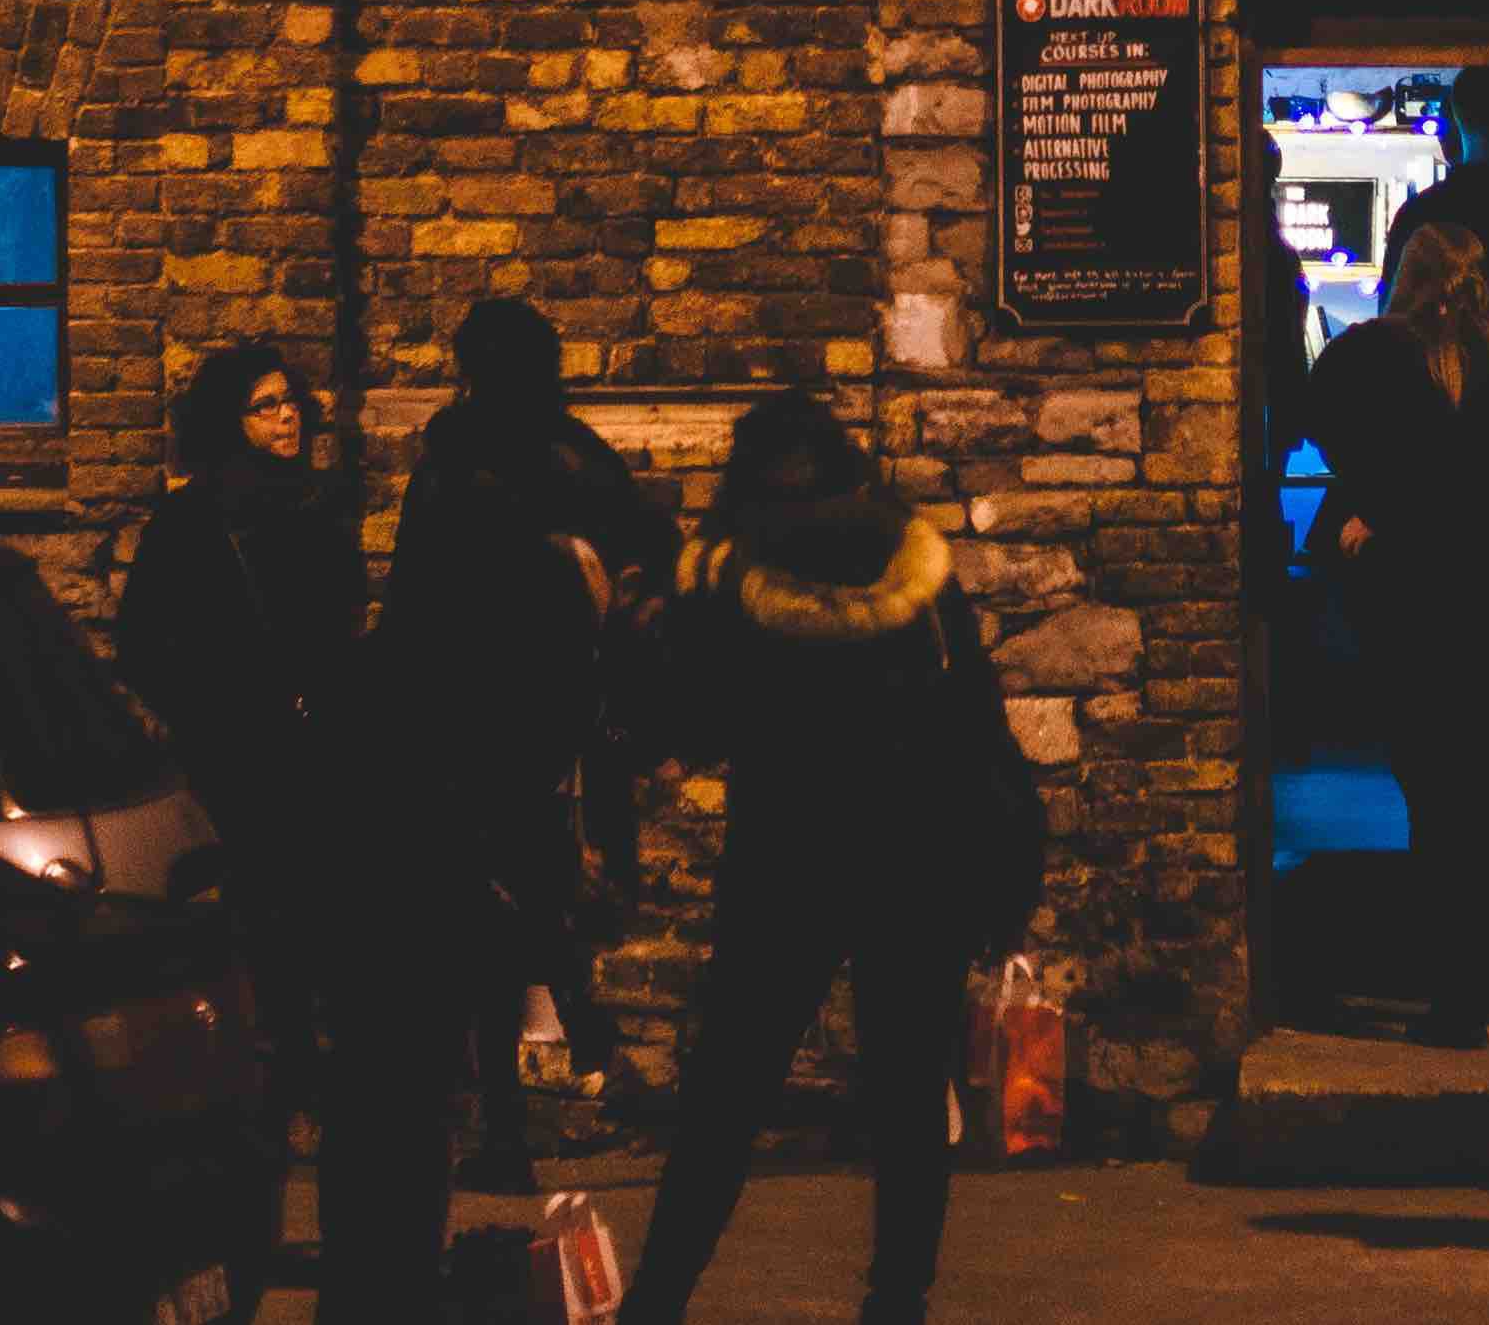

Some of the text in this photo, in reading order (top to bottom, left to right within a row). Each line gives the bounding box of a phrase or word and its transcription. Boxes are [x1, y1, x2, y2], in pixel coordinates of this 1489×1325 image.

[1041, 45, 1119, 62] COURSES
[1022, 69, 1168, 93] DIGITAL PHOTOGRAPHY
[1022, 91, 1157, 111] FILM PHOTOGRAPHY
[1023, 113, 1127, 135] MOTION FILM
[1023, 138, 1109, 159] ALTERNATIVE
[1024, 161, 1111, 182] PROCESSING
